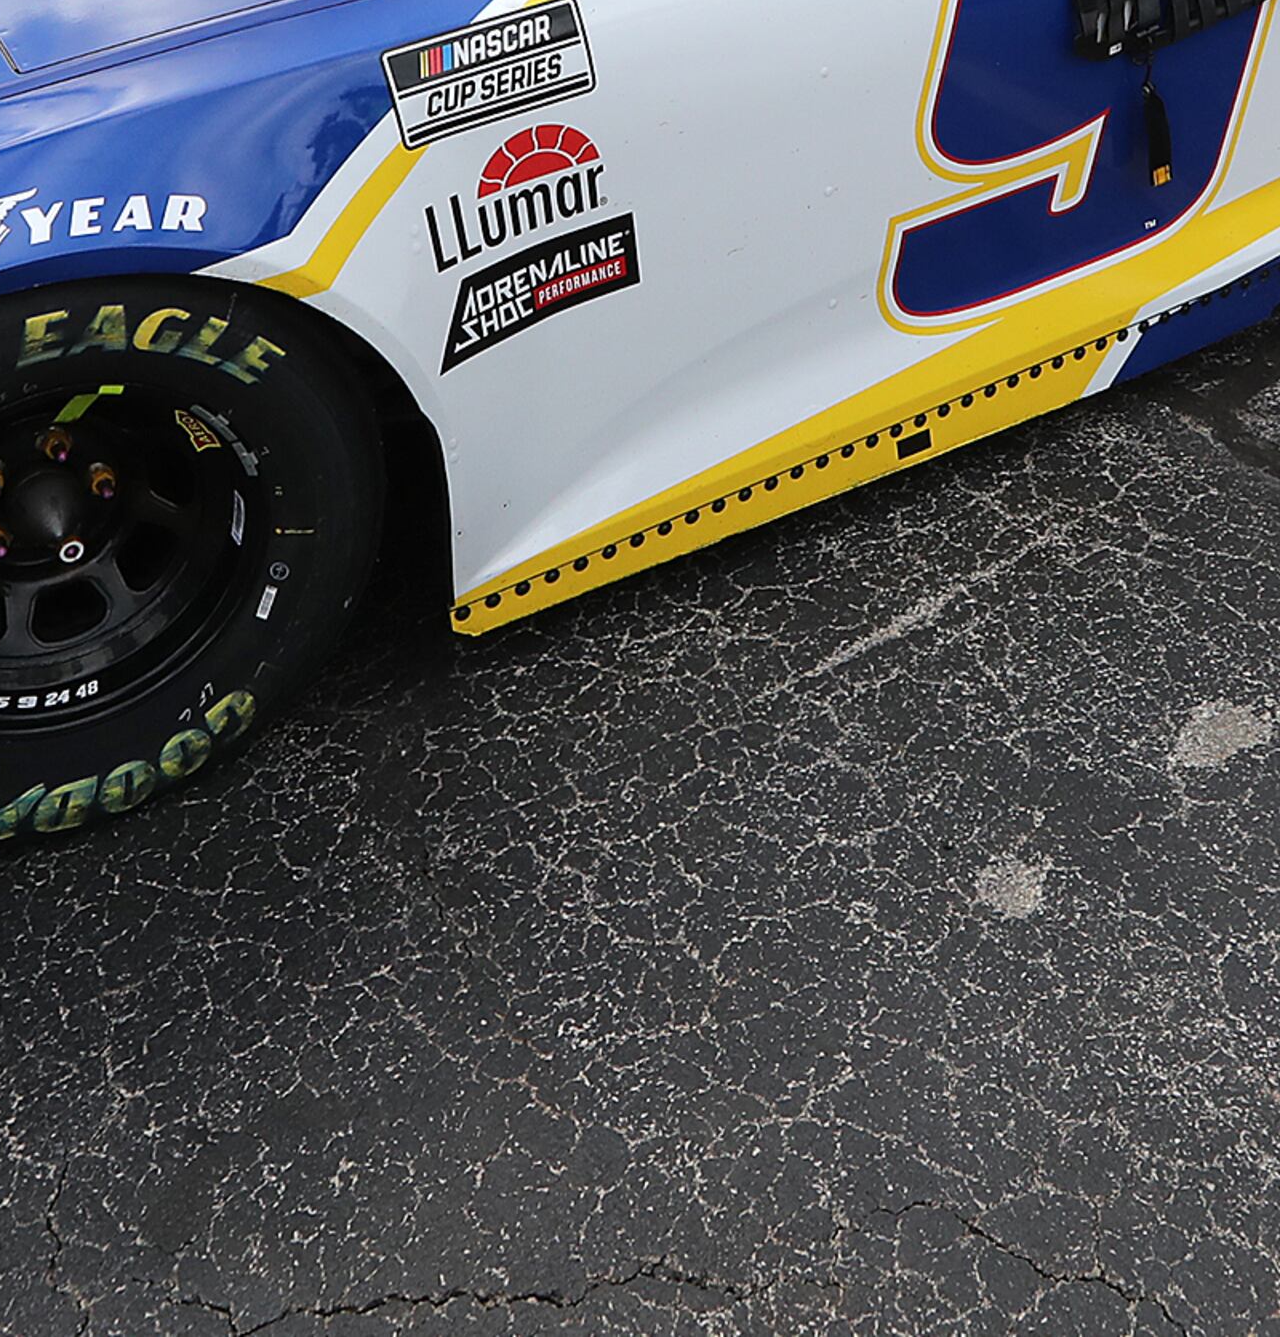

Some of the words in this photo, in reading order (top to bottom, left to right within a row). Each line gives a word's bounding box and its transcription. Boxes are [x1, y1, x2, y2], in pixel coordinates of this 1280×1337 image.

[452, 14, 552, 67] NASCAR
[426, 75, 478, 119] CUP
[480, 53, 563, 101] SERIES
[424, 163, 605, 273] LLumar
[454, 295, 534, 354] SHOC
[537, 259, 622, 305] PERFORMANCE
[461, 232, 626, 322] ADRENALINE
[15, 304, 287, 385] EAGLE
[44, 689, 70, 707] 24
[75, 679, 99, 699] 48
